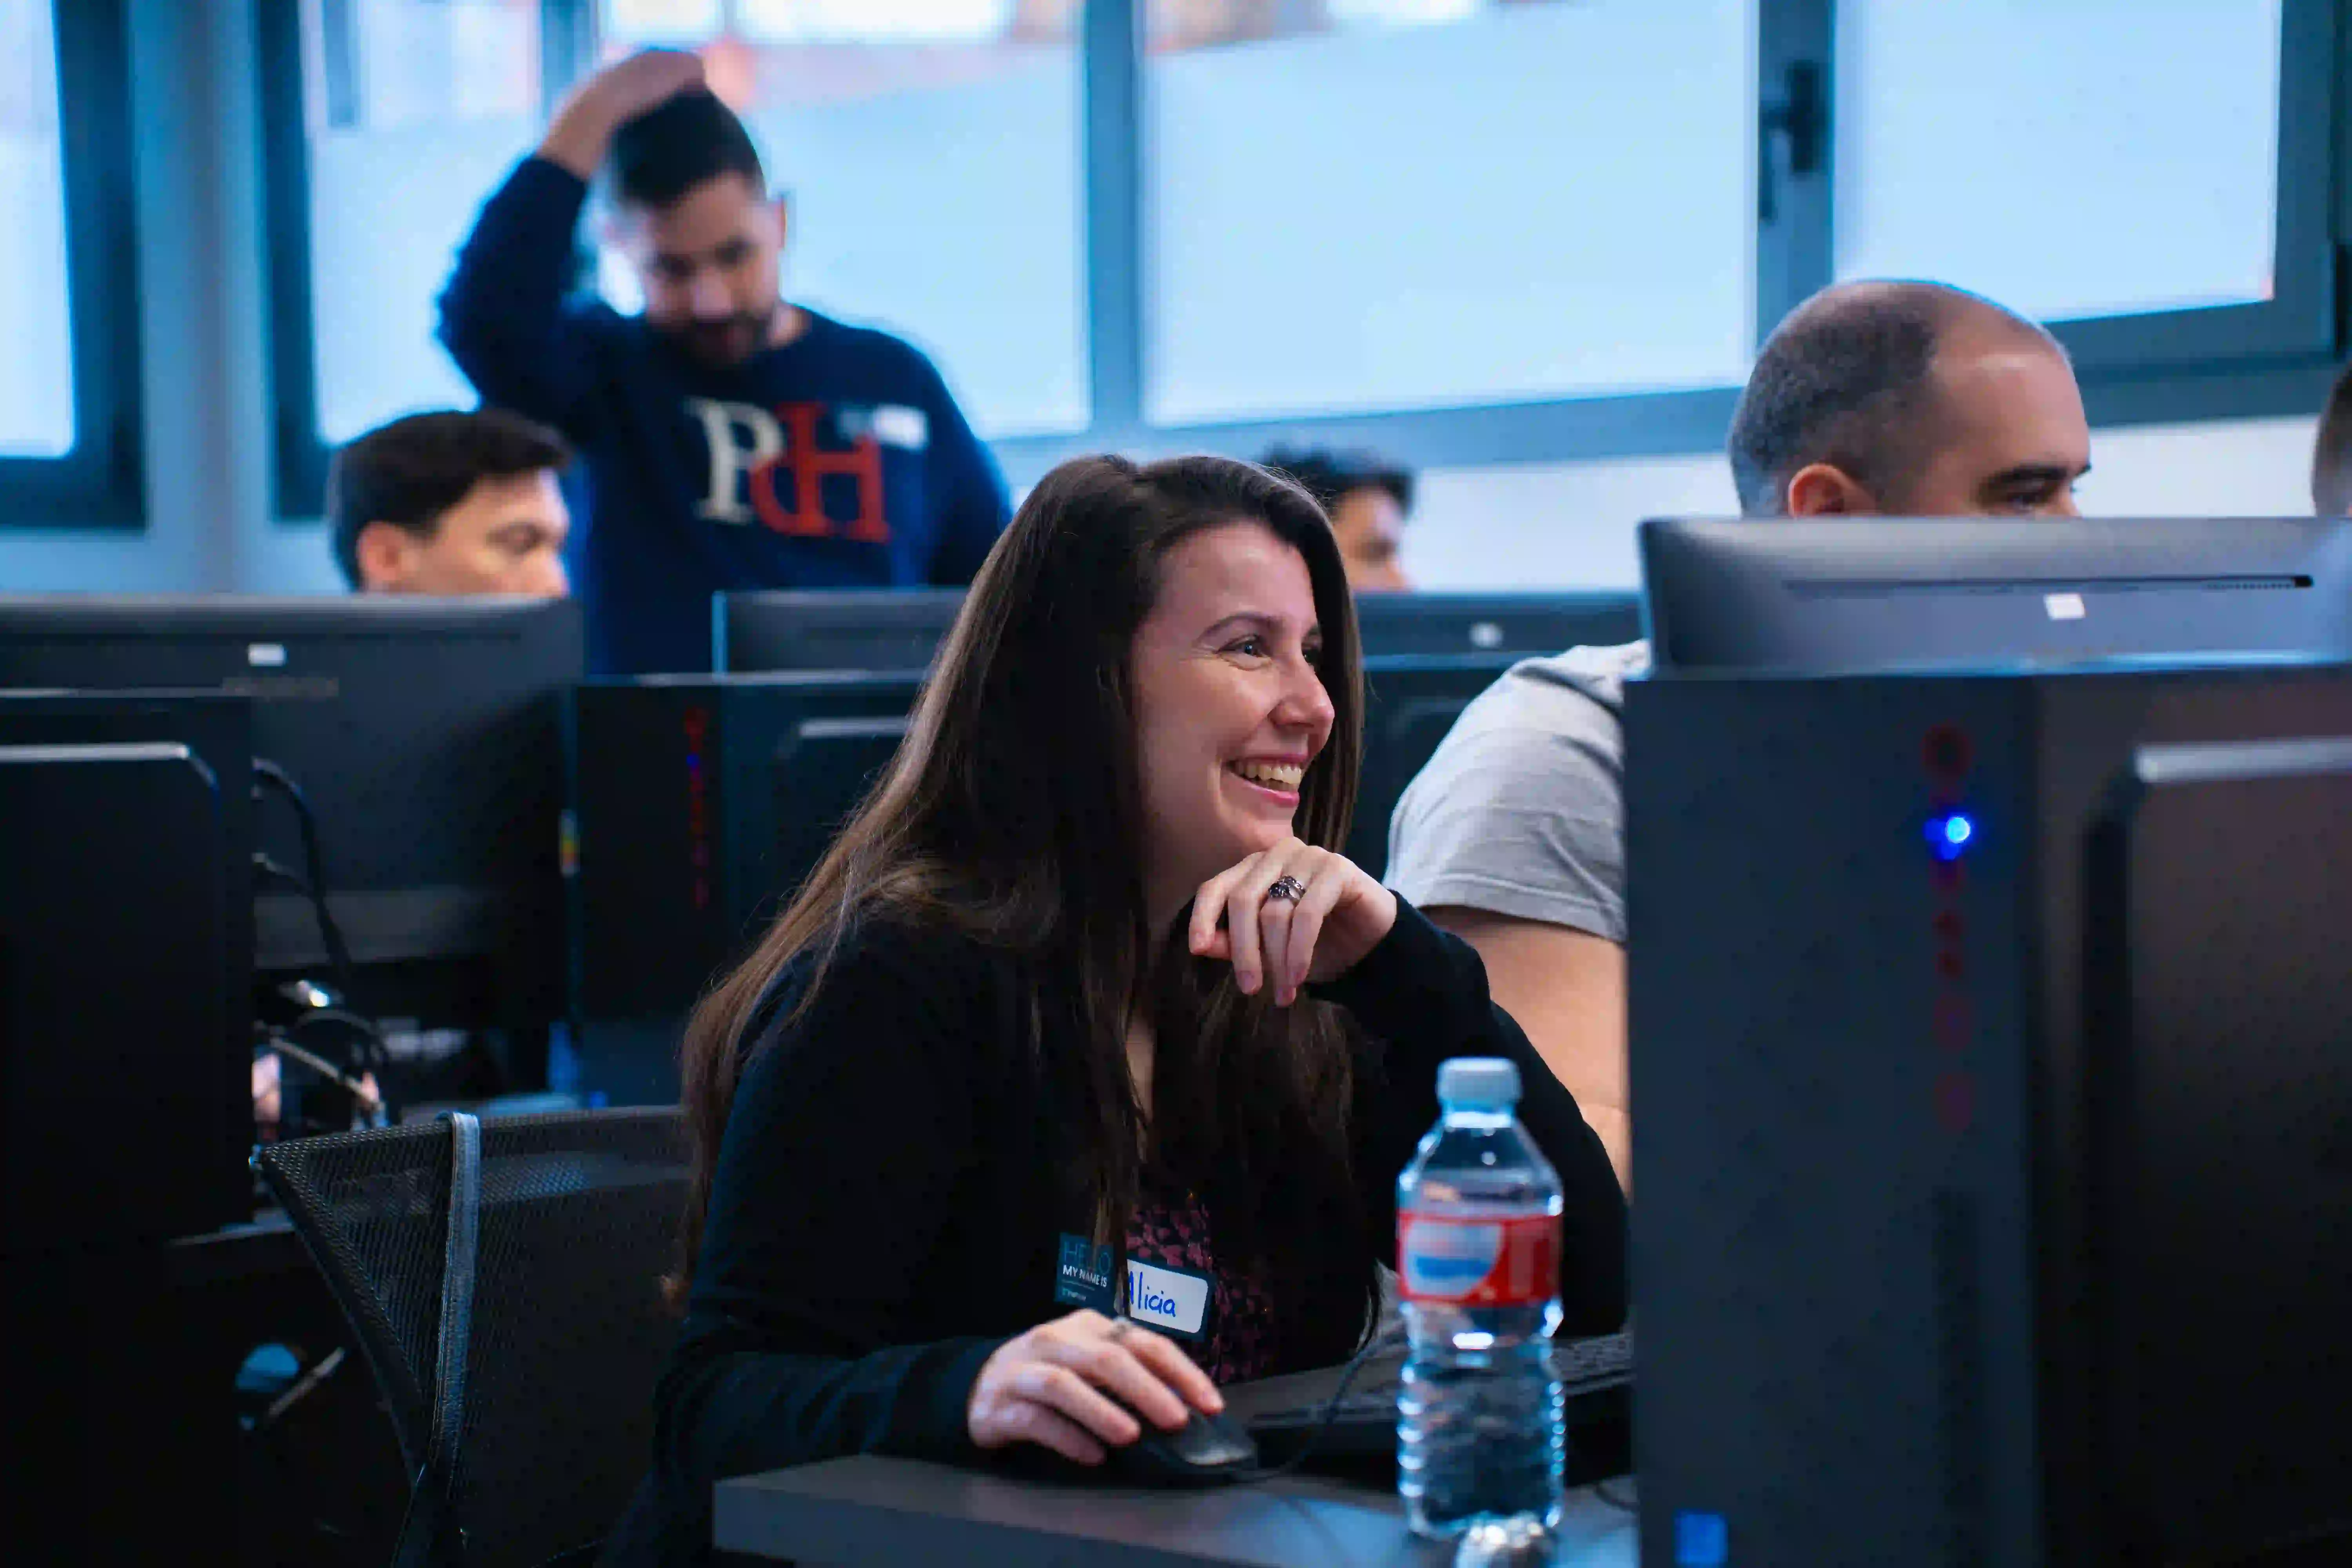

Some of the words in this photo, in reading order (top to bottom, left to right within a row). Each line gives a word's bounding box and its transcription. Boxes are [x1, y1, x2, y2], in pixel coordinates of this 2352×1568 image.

[1064, 1241, 1111, 1275] HEO
[1063, 1265, 1078, 1277] MY
[1079, 1269, 1100, 1285] NAME
[1100, 1276, 1107, 1288] IS
